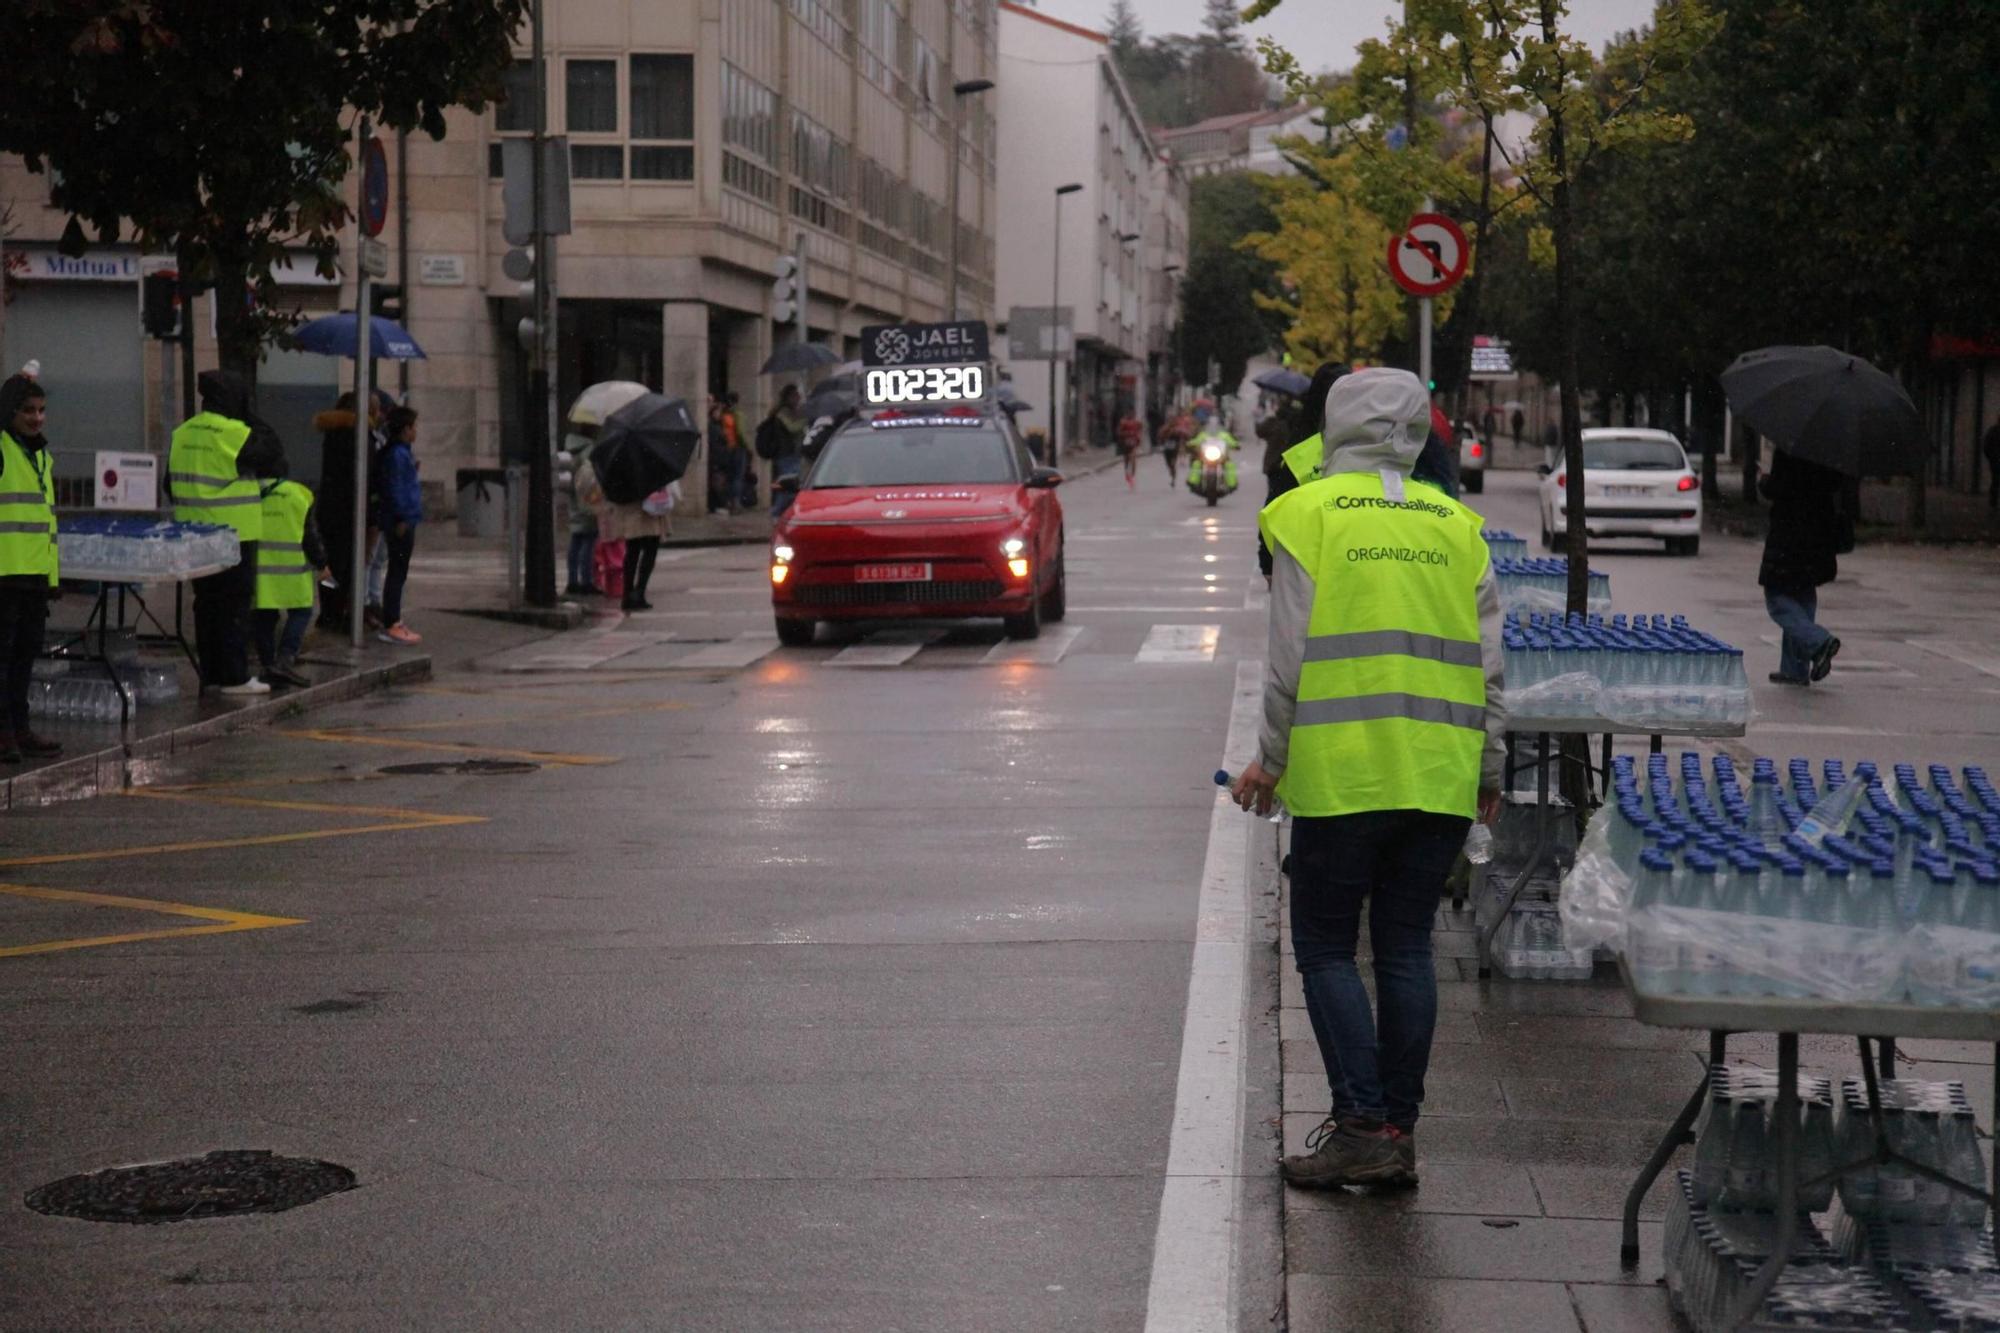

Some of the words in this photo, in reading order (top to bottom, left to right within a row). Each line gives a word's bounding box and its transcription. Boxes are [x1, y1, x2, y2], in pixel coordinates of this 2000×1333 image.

[46, 256, 117, 275] Mutua
[913, 328, 974, 346] JAEL
[867, 366, 983, 403] 002320
[1347, 547, 1449, 567] ORGANIZACIÓN
